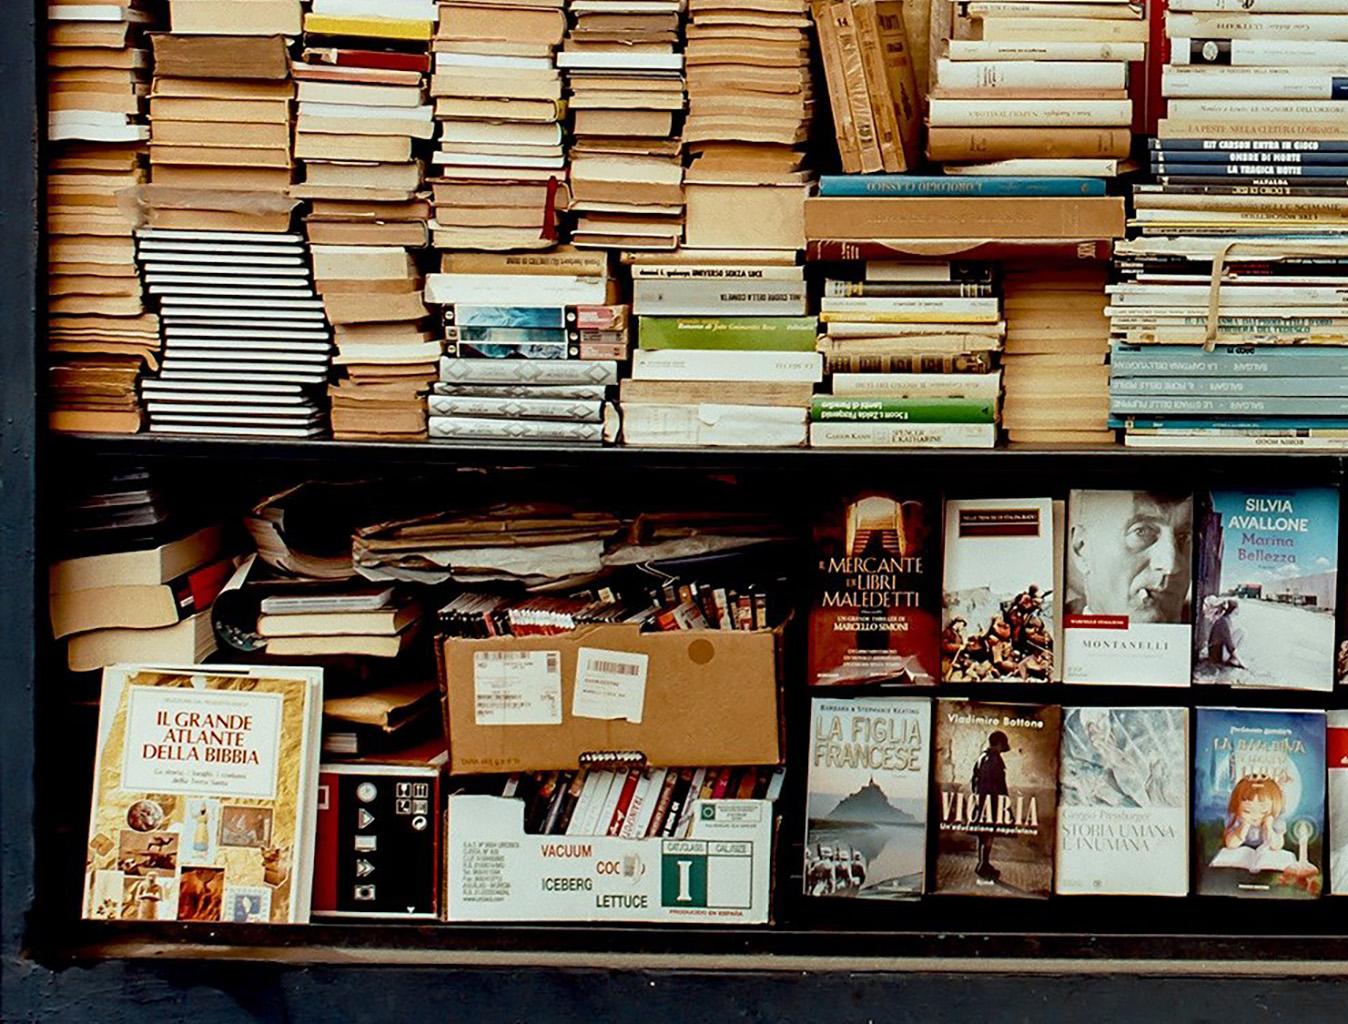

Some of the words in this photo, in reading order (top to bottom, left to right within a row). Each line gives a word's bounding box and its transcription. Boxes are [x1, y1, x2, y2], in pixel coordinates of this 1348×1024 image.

[1203, 140, 1217, 149] KIT
[1219, 141, 1251, 150] CARSON
[1253, 141, 1280, 150] ENTRA
[1293, 141, 1319, 151] GIOCO
[1229, 153, 1259, 162] OMBRE
[1227, 165, 1238, 174] LA
[1239, 165, 1274, 175] TRAGICA
[1276, 166, 1302, 175] NOTTE
[1245, 498, 1293, 514] SILVIA
[1228, 516, 1309, 532] AVALLONE
[1241, 533, 1295, 548] Marina
[1238, 548, 1297, 564] Bellezza
[857, 574, 896, 591] LIBRI
[822, 591, 920, 608] MALEDETTI
[834, 622, 877, 632] MARCELLO
[878, 622, 909, 632] SIMONI
[1082, 640, 1169, 651] MONTANELLI
[820, 704, 850, 712] BARBARA
[156, 711, 171, 726] IL
[174, 711, 253, 731] GRANDE
[948, 713, 999, 726] Vladimiro
[1003, 716, 1044, 729] Bottone
[162, 728, 245, 747] ATLANTE
[814, 715, 842, 742] LA
[851, 716, 922, 744] FIGLIA
[142, 743, 200, 762] DELLA
[204, 747, 260, 766] BIBBIA
[813, 743, 922, 772] FRANCESE
[1062, 823, 1115, 838] STORIA
[1119, 824, 1176, 838] UMANA
[541, 844, 593, 858] VACUUM
[541, 877, 593, 891] ICEBERG
[676, 860, 693, 902] I
[595, 894, 648, 908] LETTUCE
